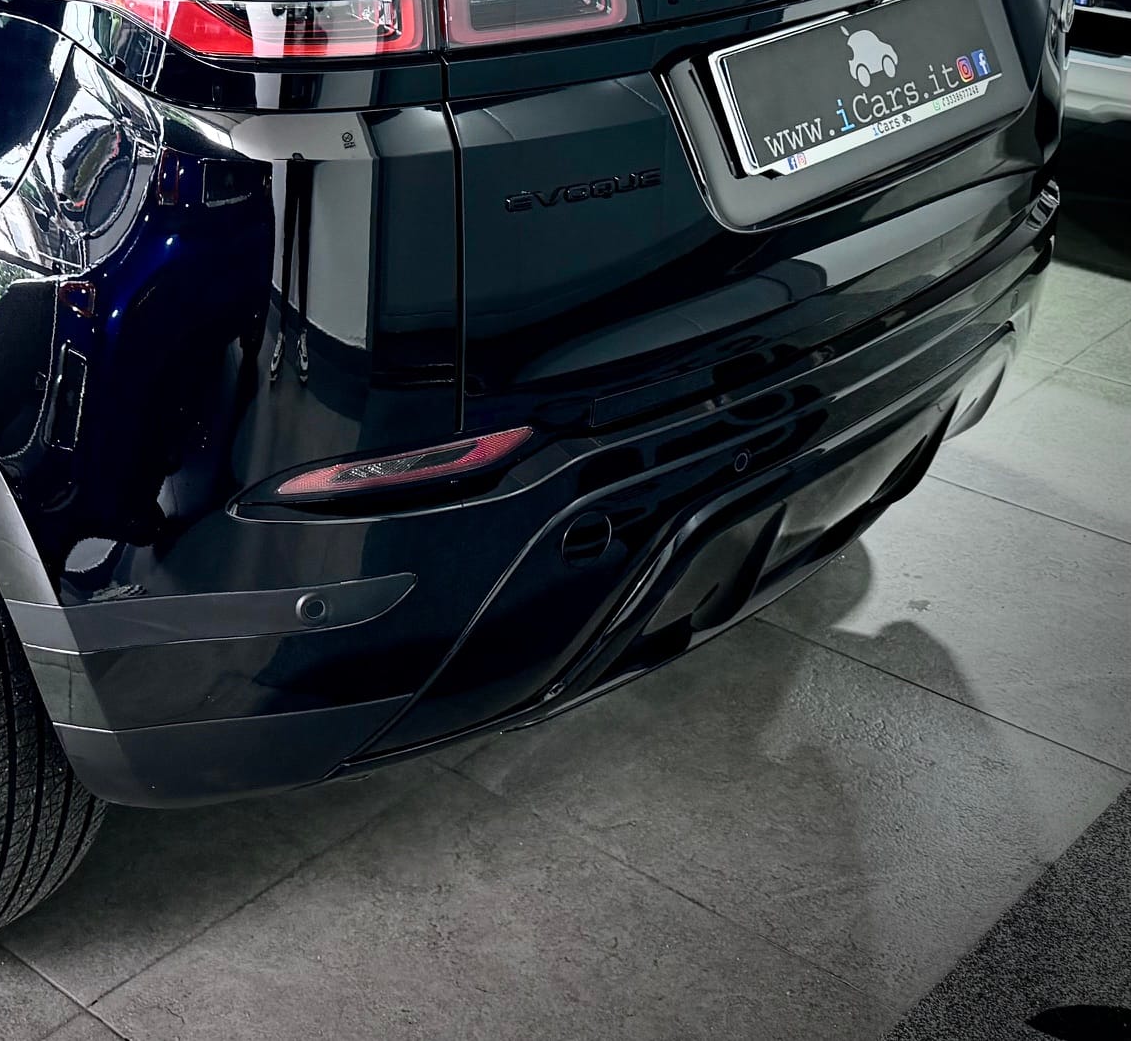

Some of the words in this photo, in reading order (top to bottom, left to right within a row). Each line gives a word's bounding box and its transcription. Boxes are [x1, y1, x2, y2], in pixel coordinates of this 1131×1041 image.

[764, 64, 959, 158] www.iCars.it
[873, 118, 900, 136] iCars
[505, 168, 661, 212] EVOQUE
